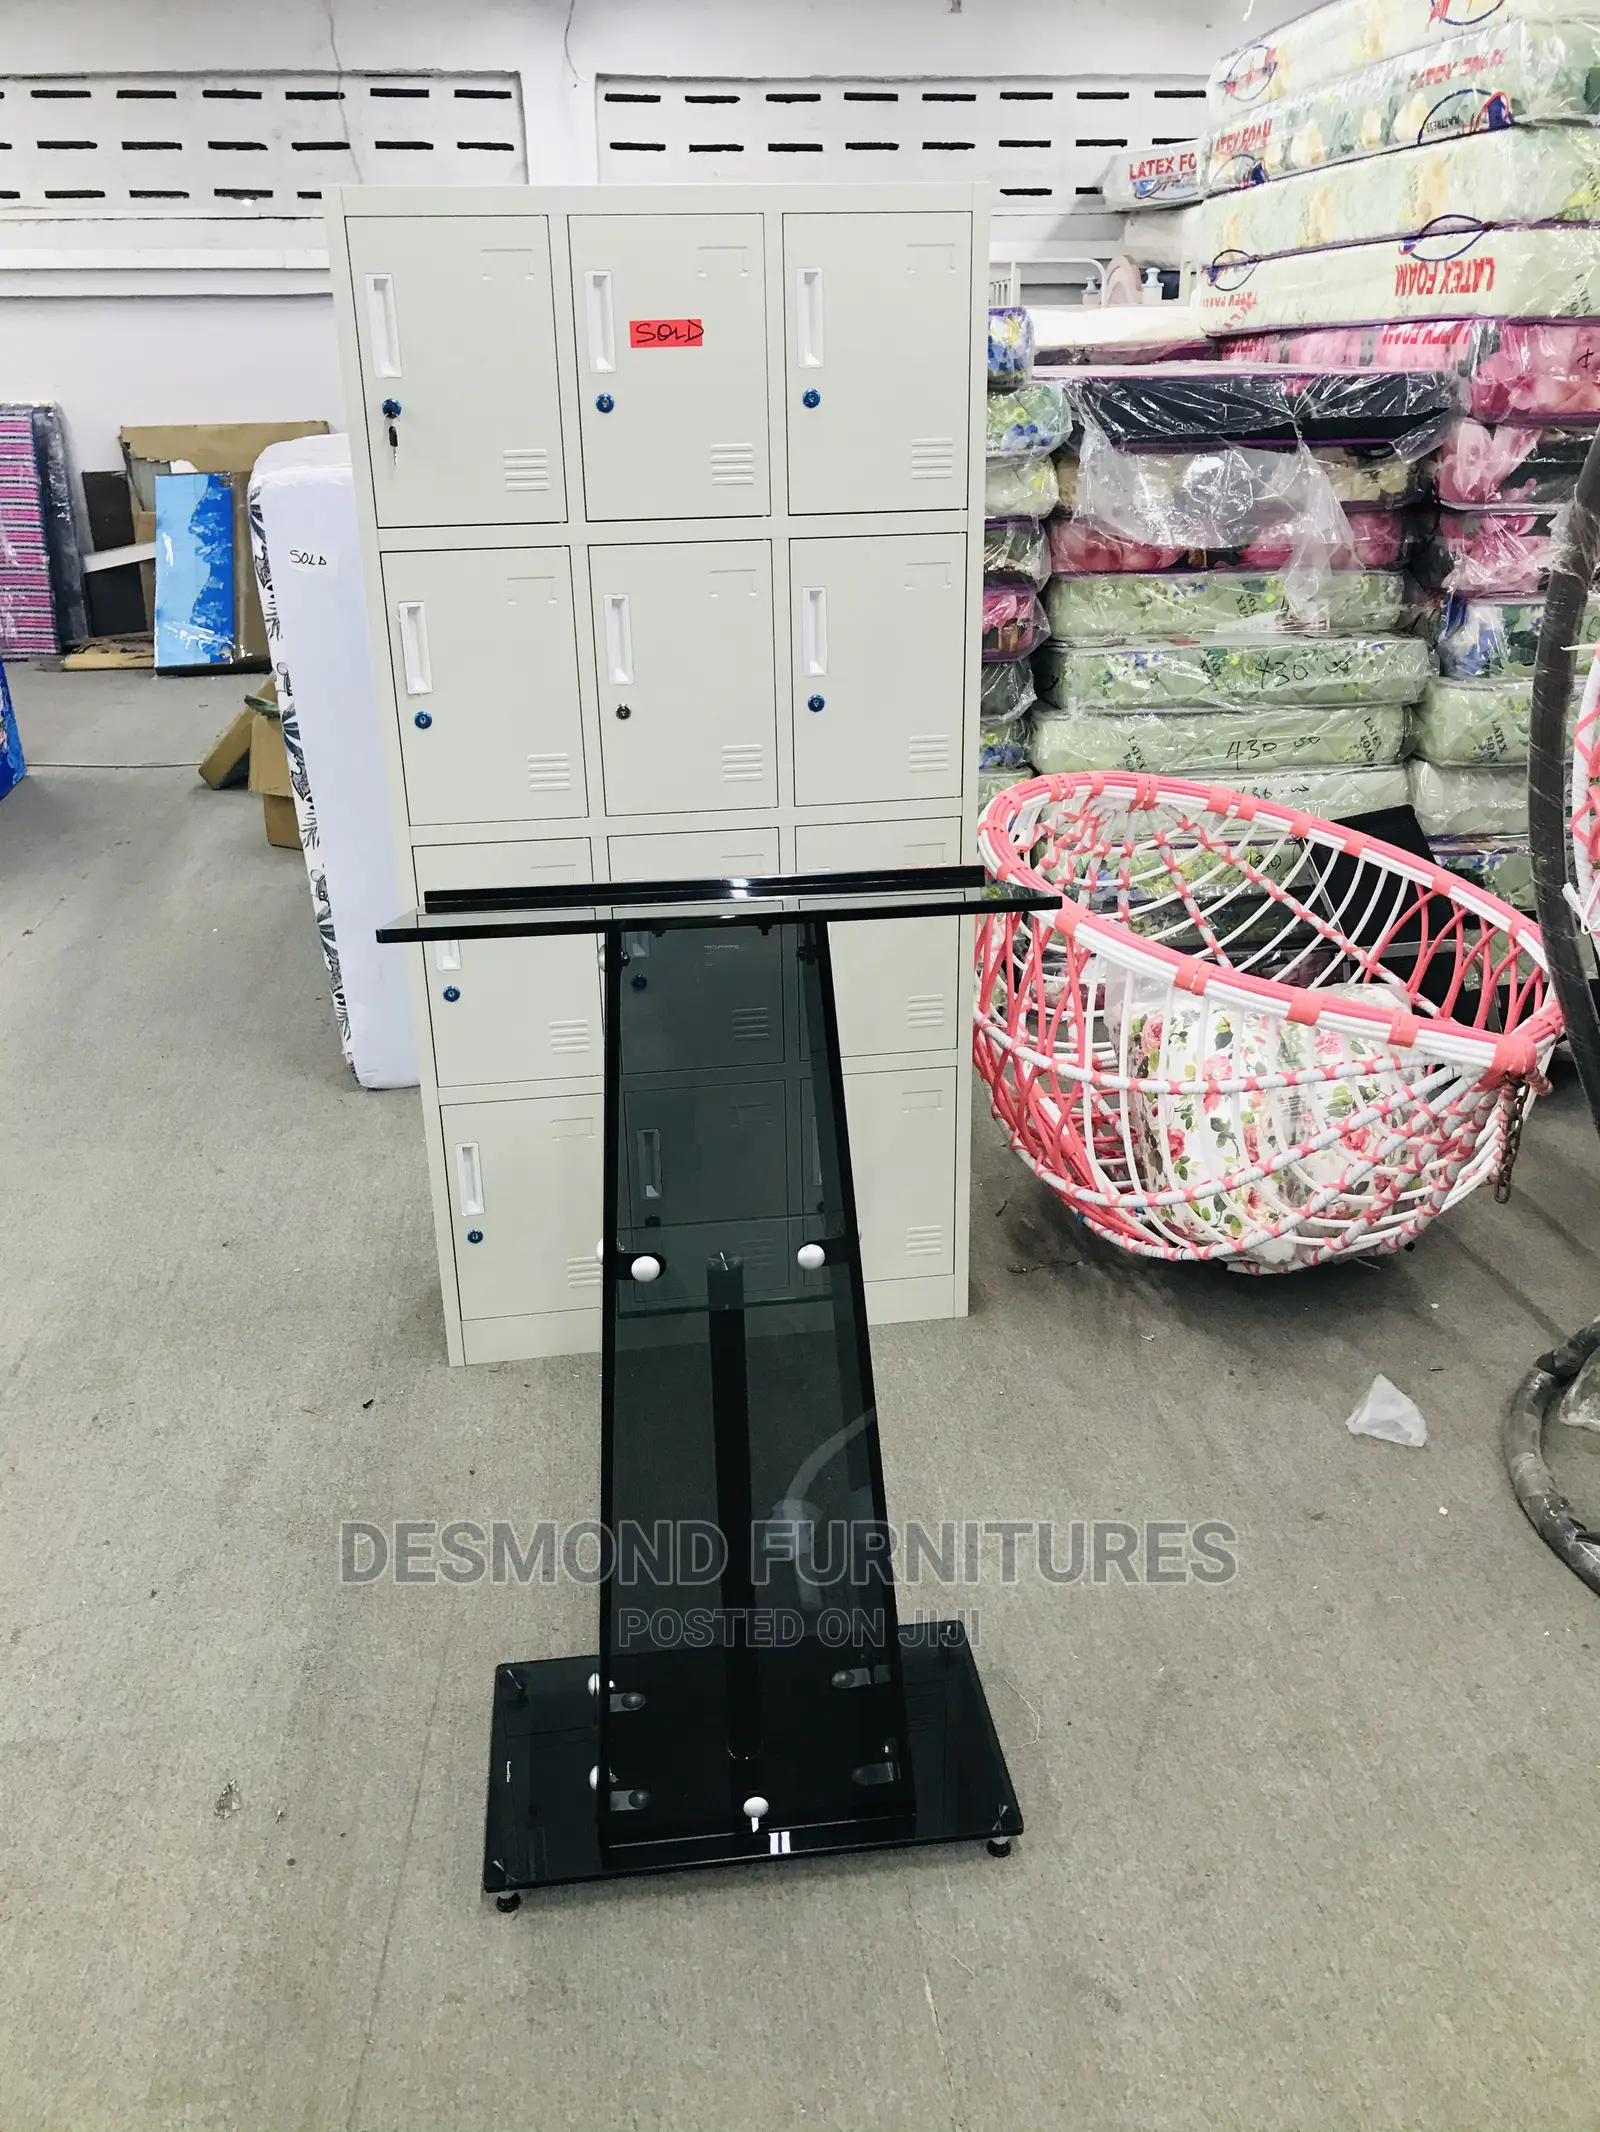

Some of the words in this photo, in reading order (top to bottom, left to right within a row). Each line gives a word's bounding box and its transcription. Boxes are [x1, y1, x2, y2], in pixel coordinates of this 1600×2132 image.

[1129, 156, 1175, 180] LATEX
[1395, 260, 1438, 297] FOAM
[1439, 257, 1496, 294] LATEX
[635, 319, 705, 344] SOLD
[289, 549, 328, 566] SOLD
[1254, 656, 1309, 690] 430
[1364, 716, 1382, 750] LATEX
[1491, 720, 1508, 754] LATEX
[1225, 738, 1278, 771] 430
